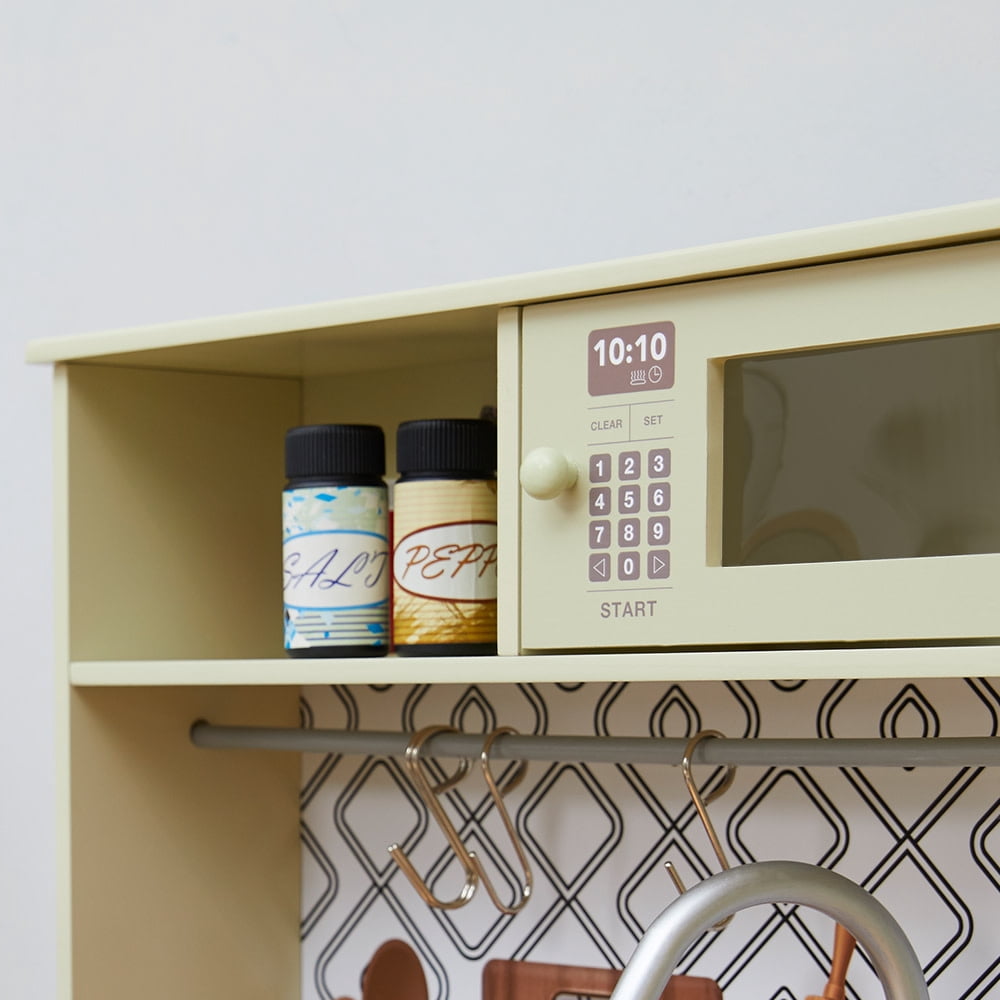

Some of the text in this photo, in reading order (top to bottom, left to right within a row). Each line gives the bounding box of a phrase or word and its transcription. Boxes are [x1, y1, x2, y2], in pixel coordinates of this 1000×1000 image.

[593, 332, 667, 366] 10:10
[590, 418, 623, 431] CLEAR
[643, 414, 663, 426] SET
[595, 455, 664, 477] 1 2 3
[594, 488, 664, 510] 4 5 6
[594, 522, 664, 544] 7 8 9
[402, 543, 497, 580] PEPP
[623, 558, 634, 576] 0
[600, 601, 657, 618] START
